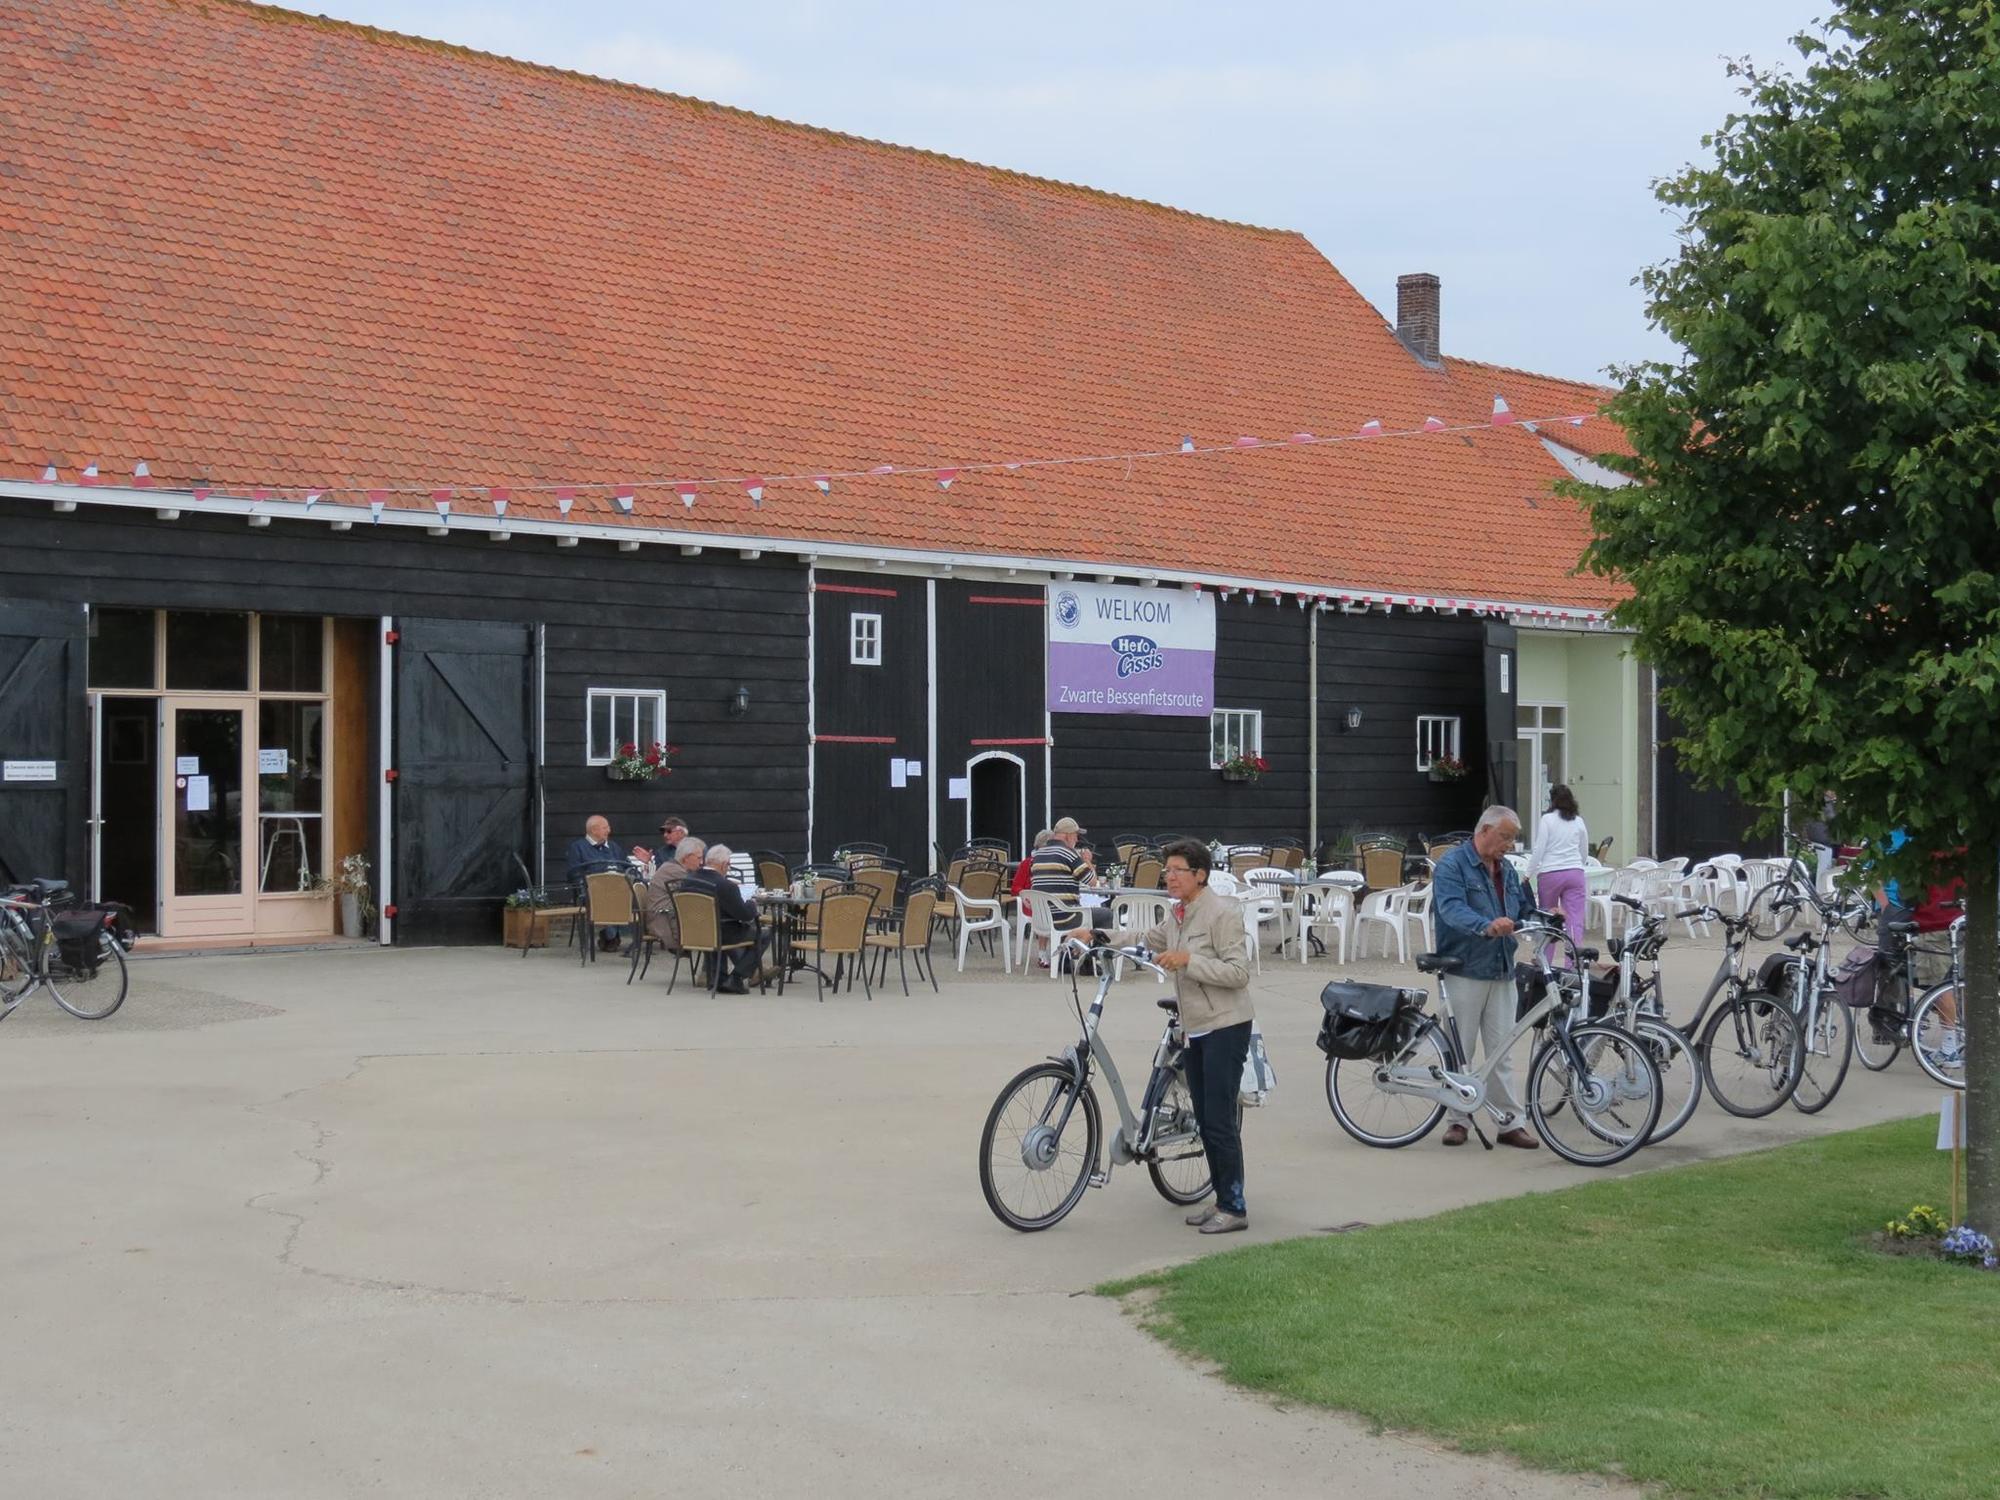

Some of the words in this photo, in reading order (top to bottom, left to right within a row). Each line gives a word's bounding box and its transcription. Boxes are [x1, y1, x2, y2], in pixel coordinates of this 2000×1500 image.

[1096, 598, 1171, 624] WELKOM
[1118, 638, 1150, 653] Hero
[1117, 649, 1163, 678] Cassis
[1060, 685, 1103, 704] Zwarte
[1107, 687, 1204, 708] Bessenfietsroute
